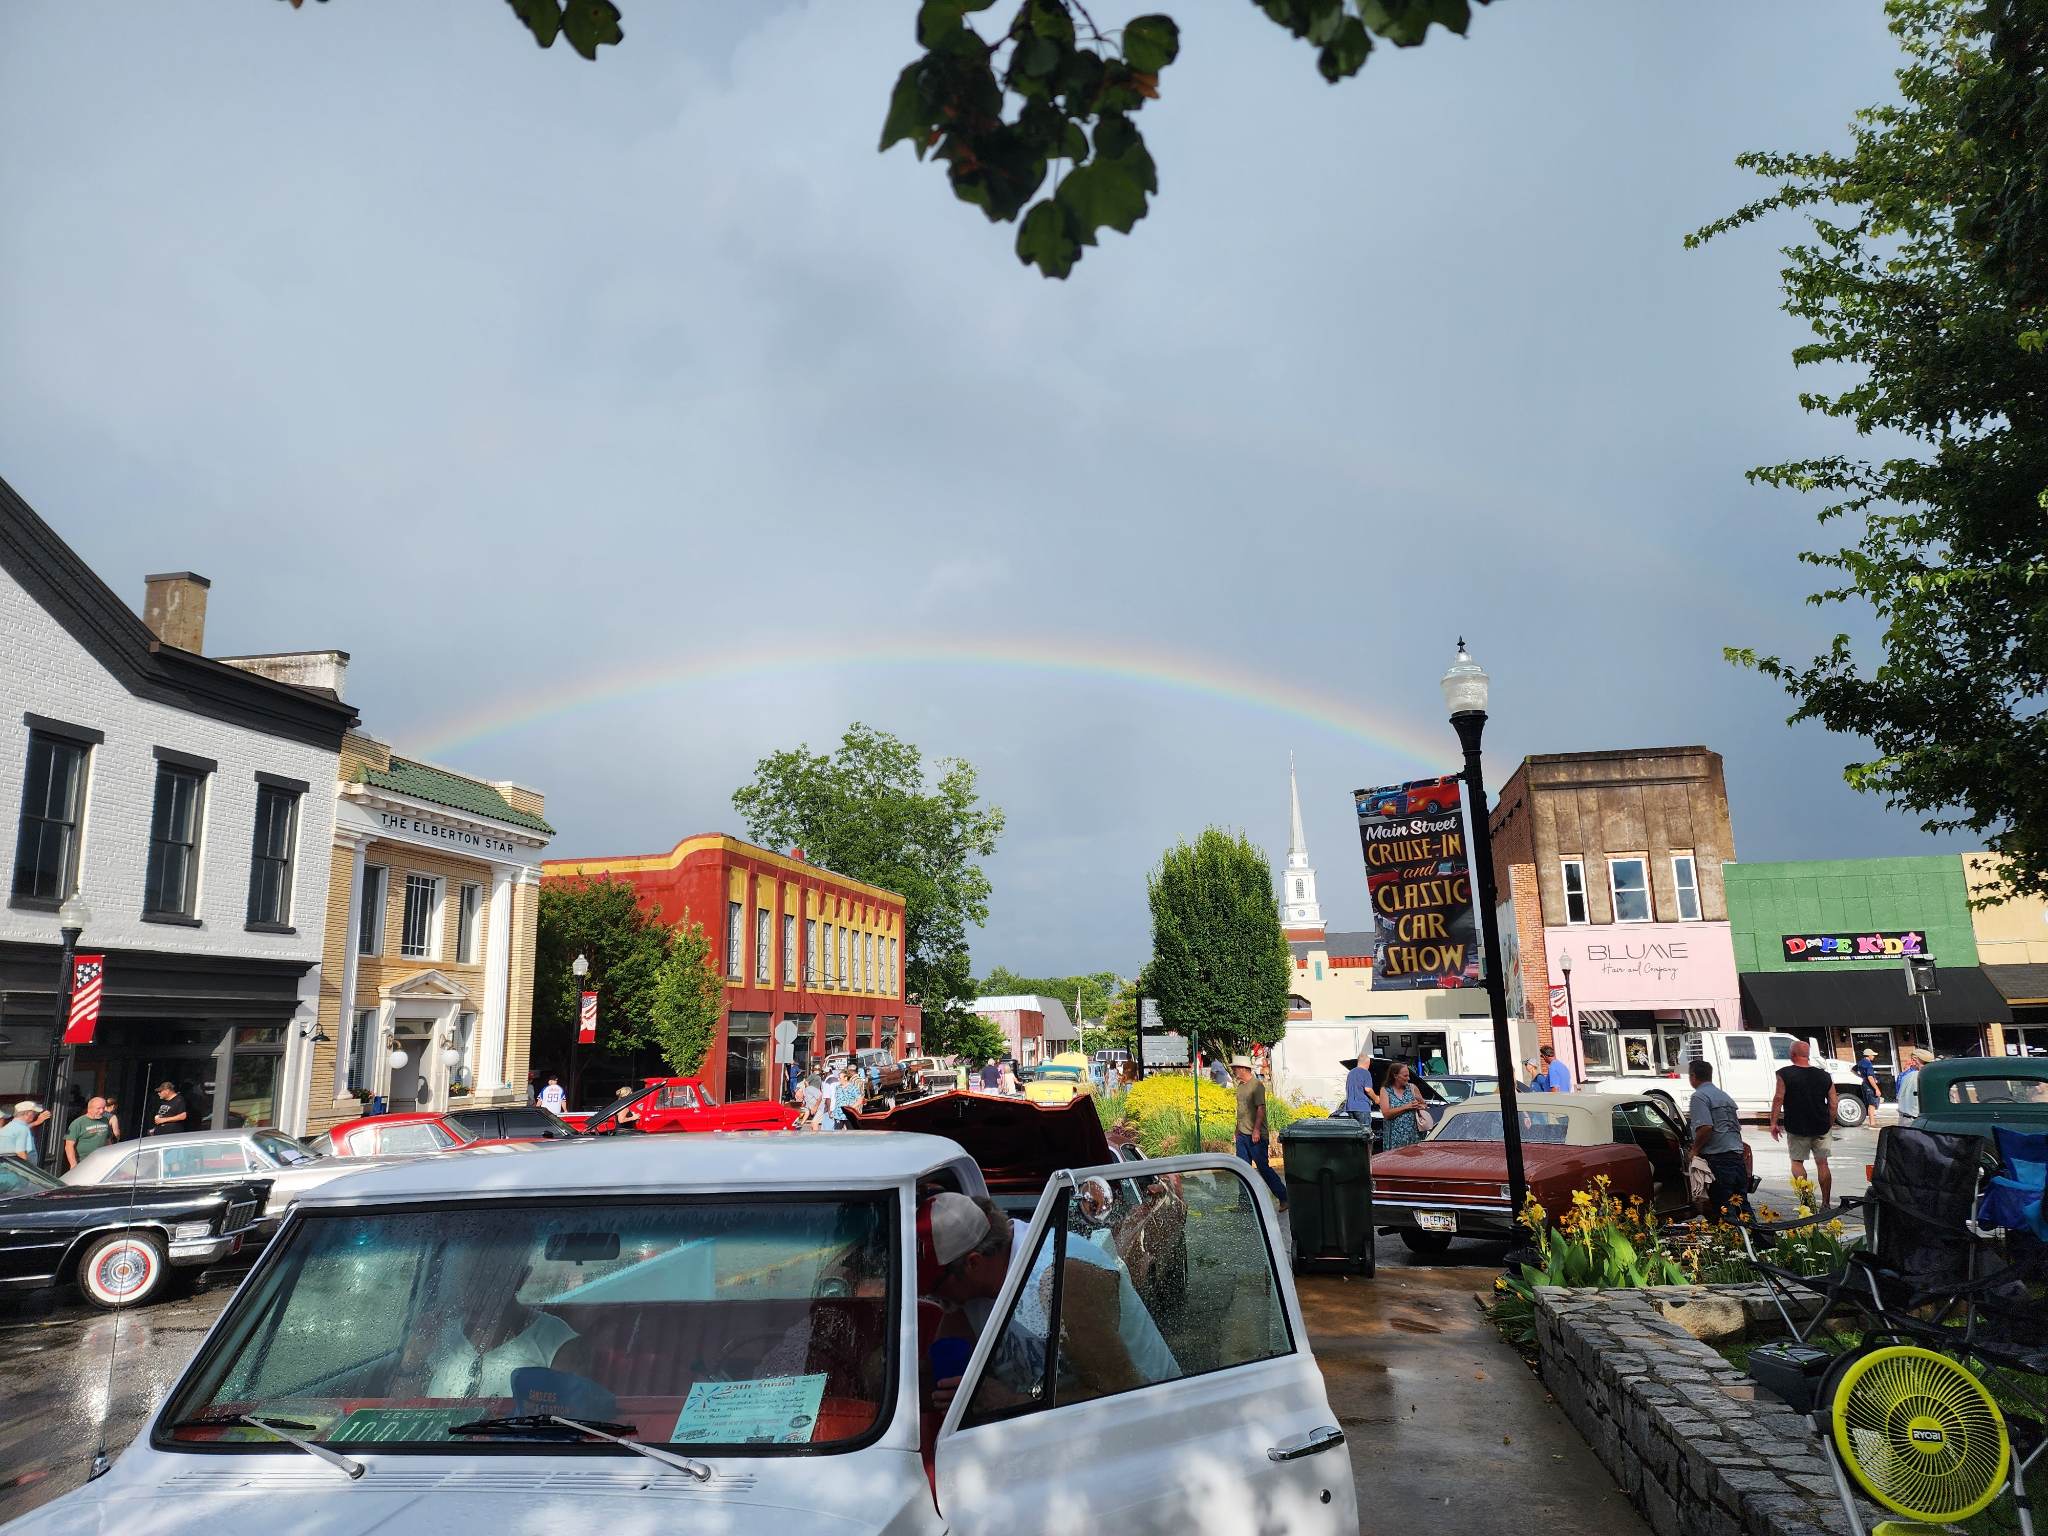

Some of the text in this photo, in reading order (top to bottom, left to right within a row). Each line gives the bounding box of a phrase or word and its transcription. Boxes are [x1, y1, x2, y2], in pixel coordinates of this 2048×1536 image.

[381, 814, 514, 854] THE ELBERTON STAR
[1366, 816, 1458, 842] Main Street
[1368, 833, 1463, 866] CRUISE-IN
[1403, 861, 1435, 879] and
[1377, 878, 1467, 914] CLASSIC
[1398, 912, 1450, 942] CAR
[1386, 943, 1465, 976] SHOW
[1587, 942, 1689, 961] BLUME
[1601, 962, 1626, 975] Hair
[1628, 961, 1642, 976] and
[547, 1093, 559, 1103] 99
[1912, 1430, 1941, 1441] RYOBI
